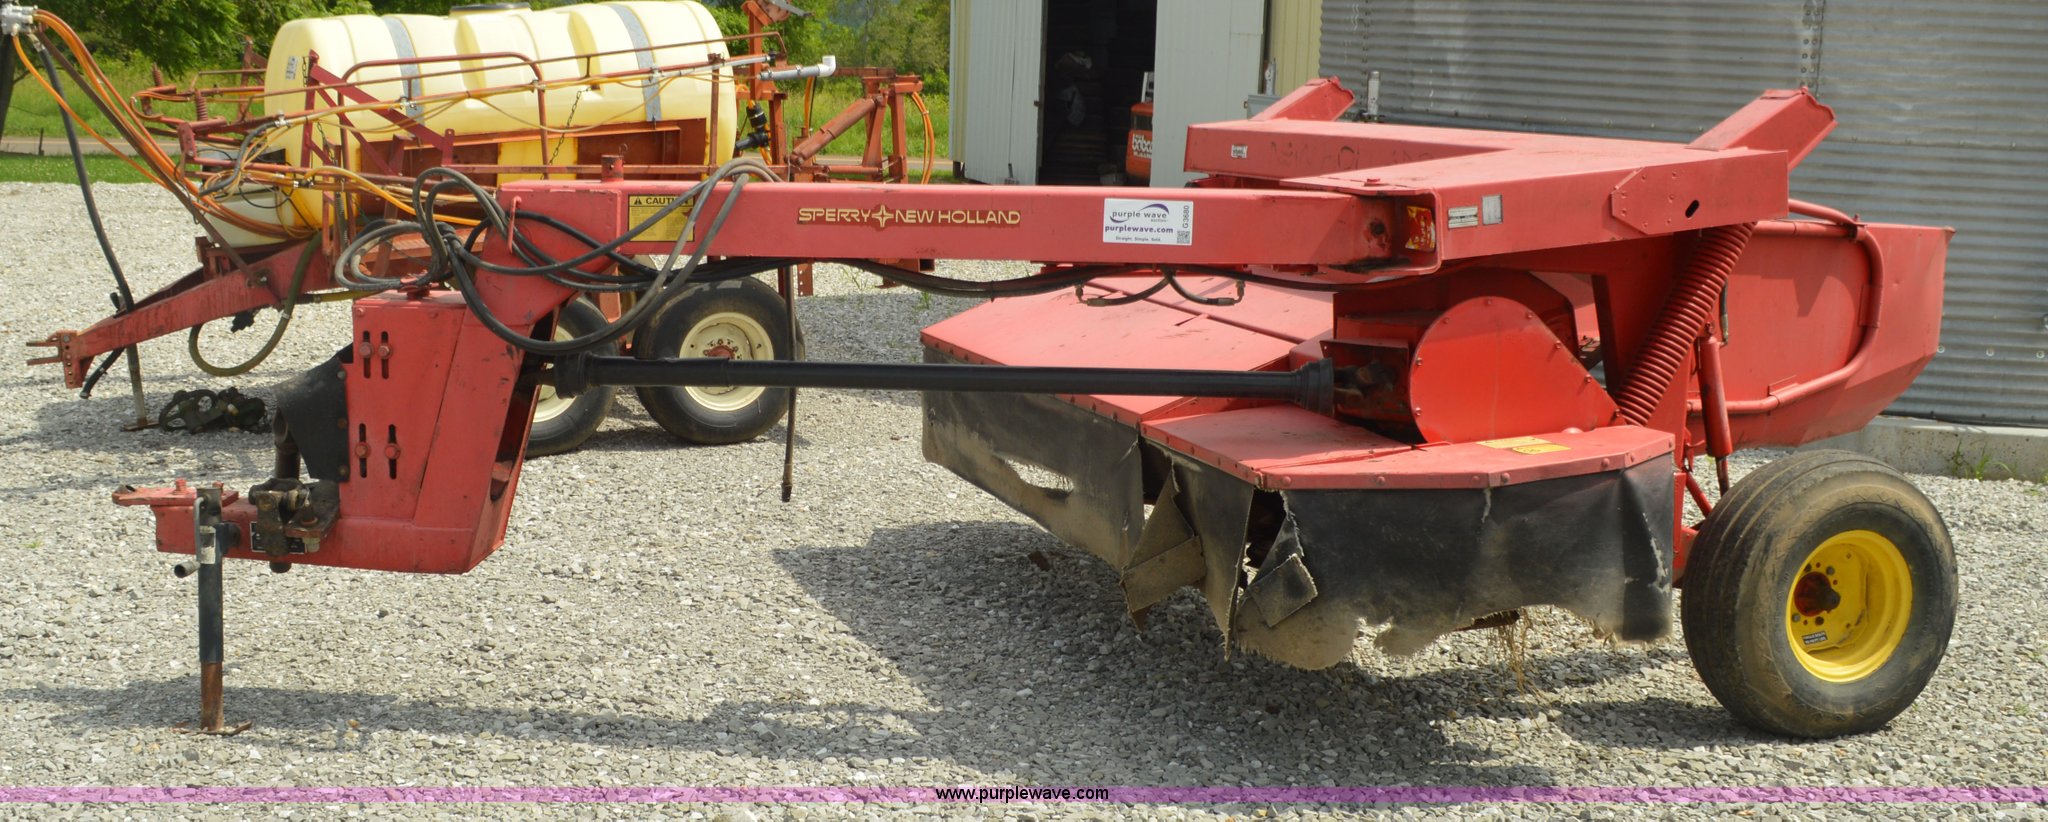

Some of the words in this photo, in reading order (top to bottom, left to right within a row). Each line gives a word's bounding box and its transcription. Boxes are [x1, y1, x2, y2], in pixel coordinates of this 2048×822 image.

[646, 197, 689, 205] CAUT
[799, 208, 871, 222] SPERRY
[895, 210, 934, 223] NEW
[938, 210, 1021, 225] HOLLAND
[1112, 211, 1141, 219] purple
[1182, 205, 1190, 229] G3680
[1104, 224, 1174, 234] purplewave.com
